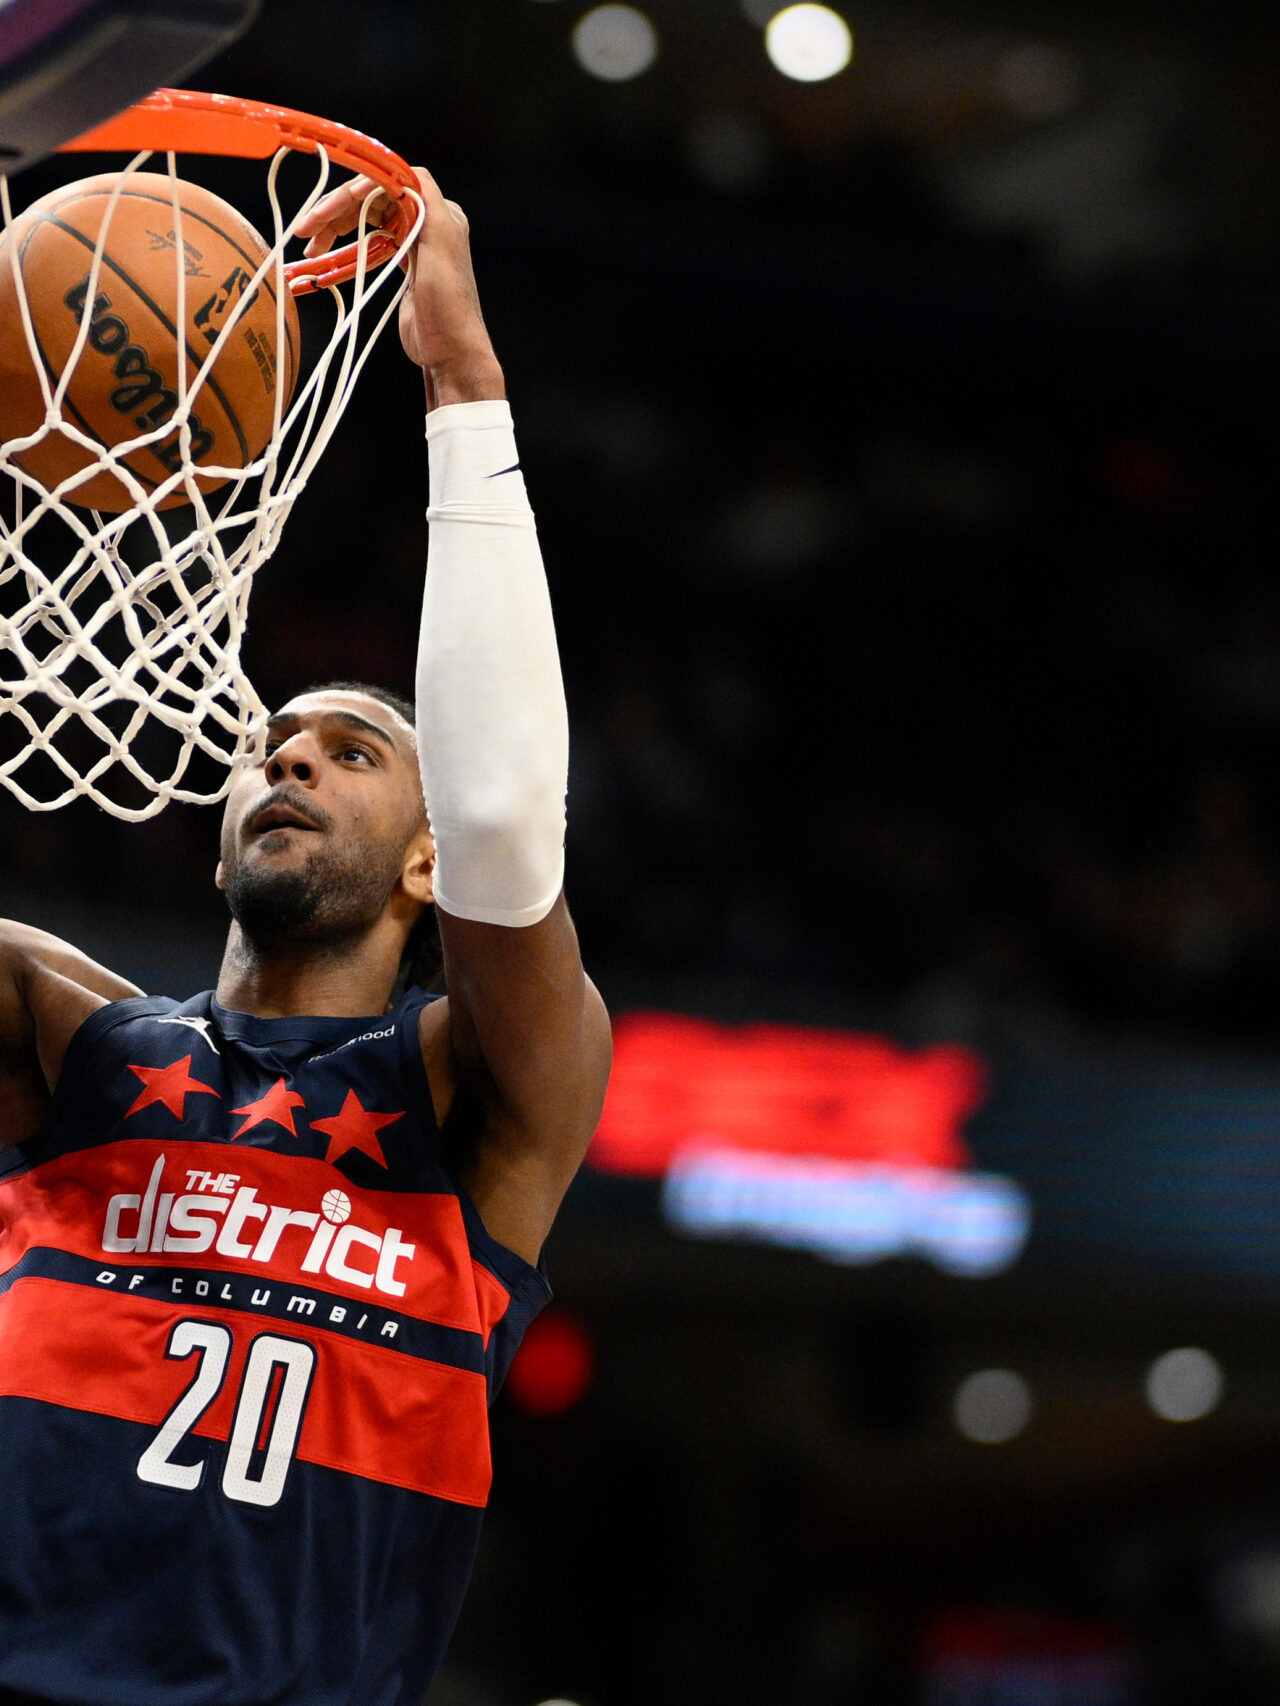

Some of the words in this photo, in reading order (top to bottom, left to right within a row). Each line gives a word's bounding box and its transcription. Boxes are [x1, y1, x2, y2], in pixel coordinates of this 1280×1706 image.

[102, 1152, 416, 1297] district
[185, 1169, 241, 1194] THE
[96, 1270, 144, 1290] OF
[171, 1277, 399, 1338] COLUMBIA
[136, 1320, 316, 1508] 20
